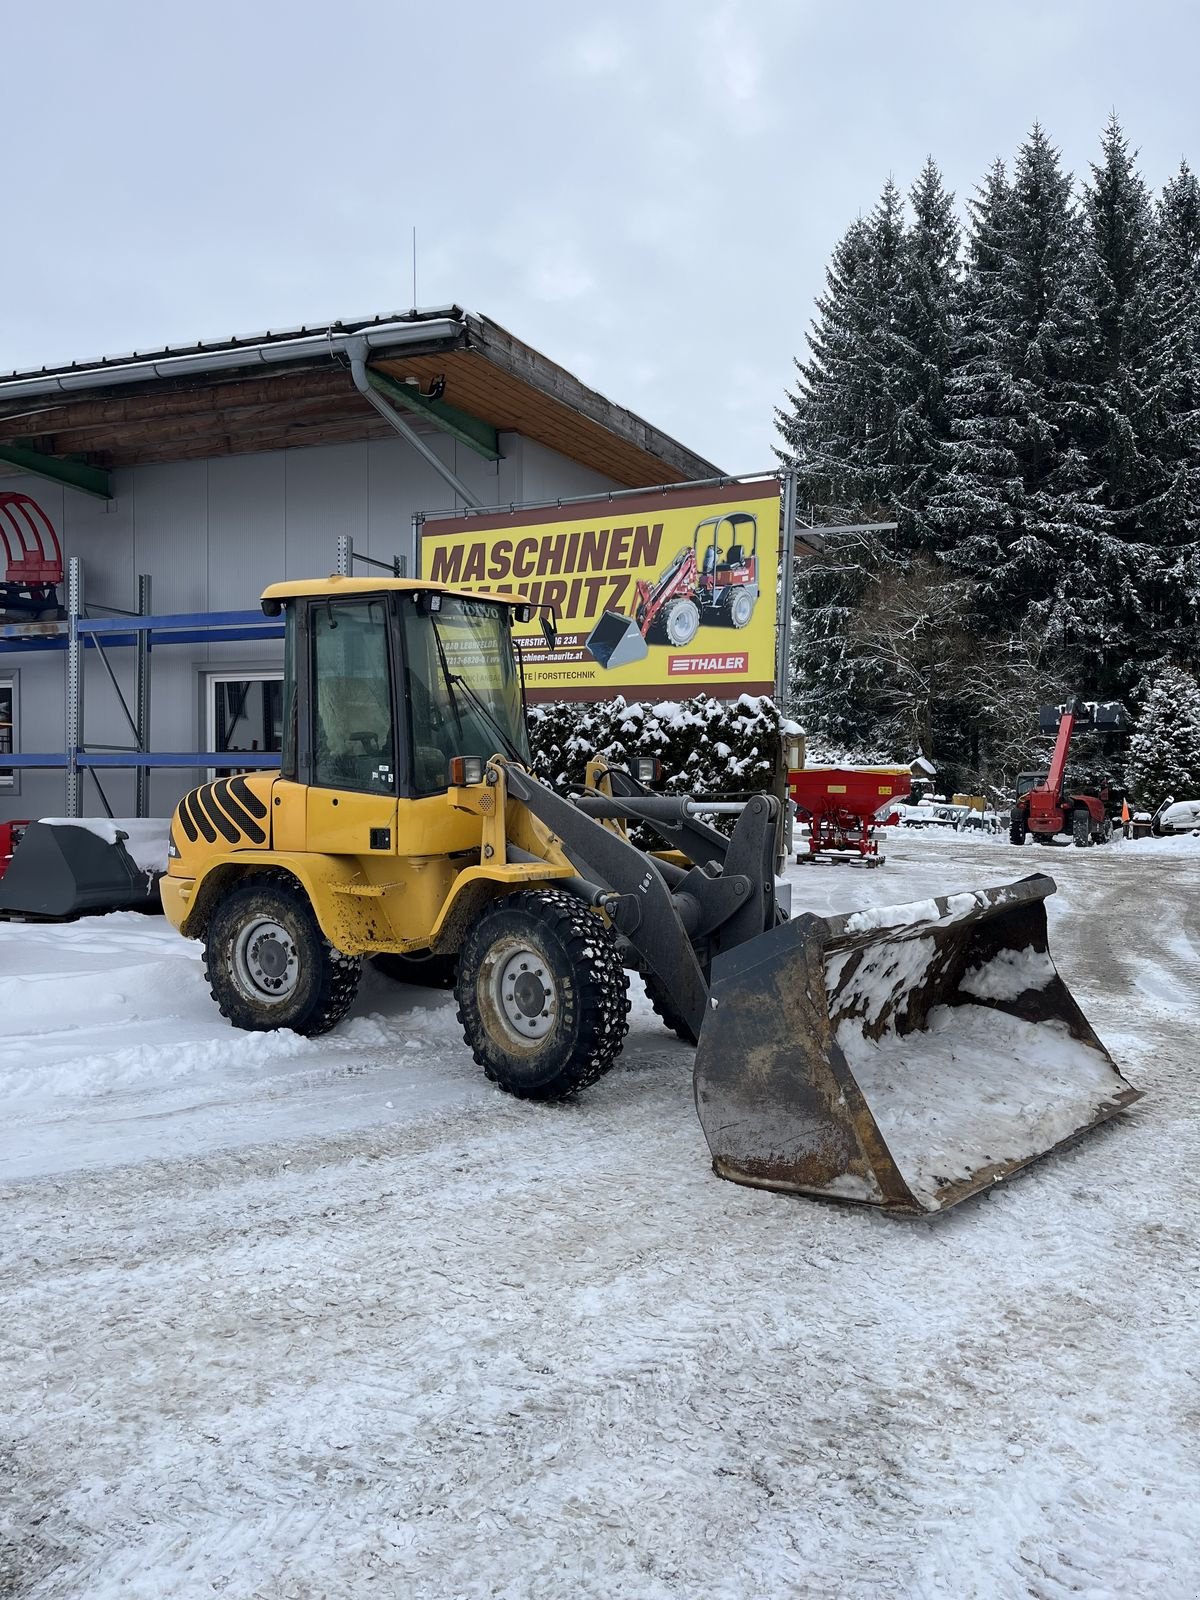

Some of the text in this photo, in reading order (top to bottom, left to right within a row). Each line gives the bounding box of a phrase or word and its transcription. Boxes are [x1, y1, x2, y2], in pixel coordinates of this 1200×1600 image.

[430, 523, 664, 583] MASCHINEN
[454, 602, 499, 619] VOLVO
[563, 636, 578, 645] 23A
[690, 656, 745, 670] THALER
[538, 671, 596, 680] FORSTTECHNIK
